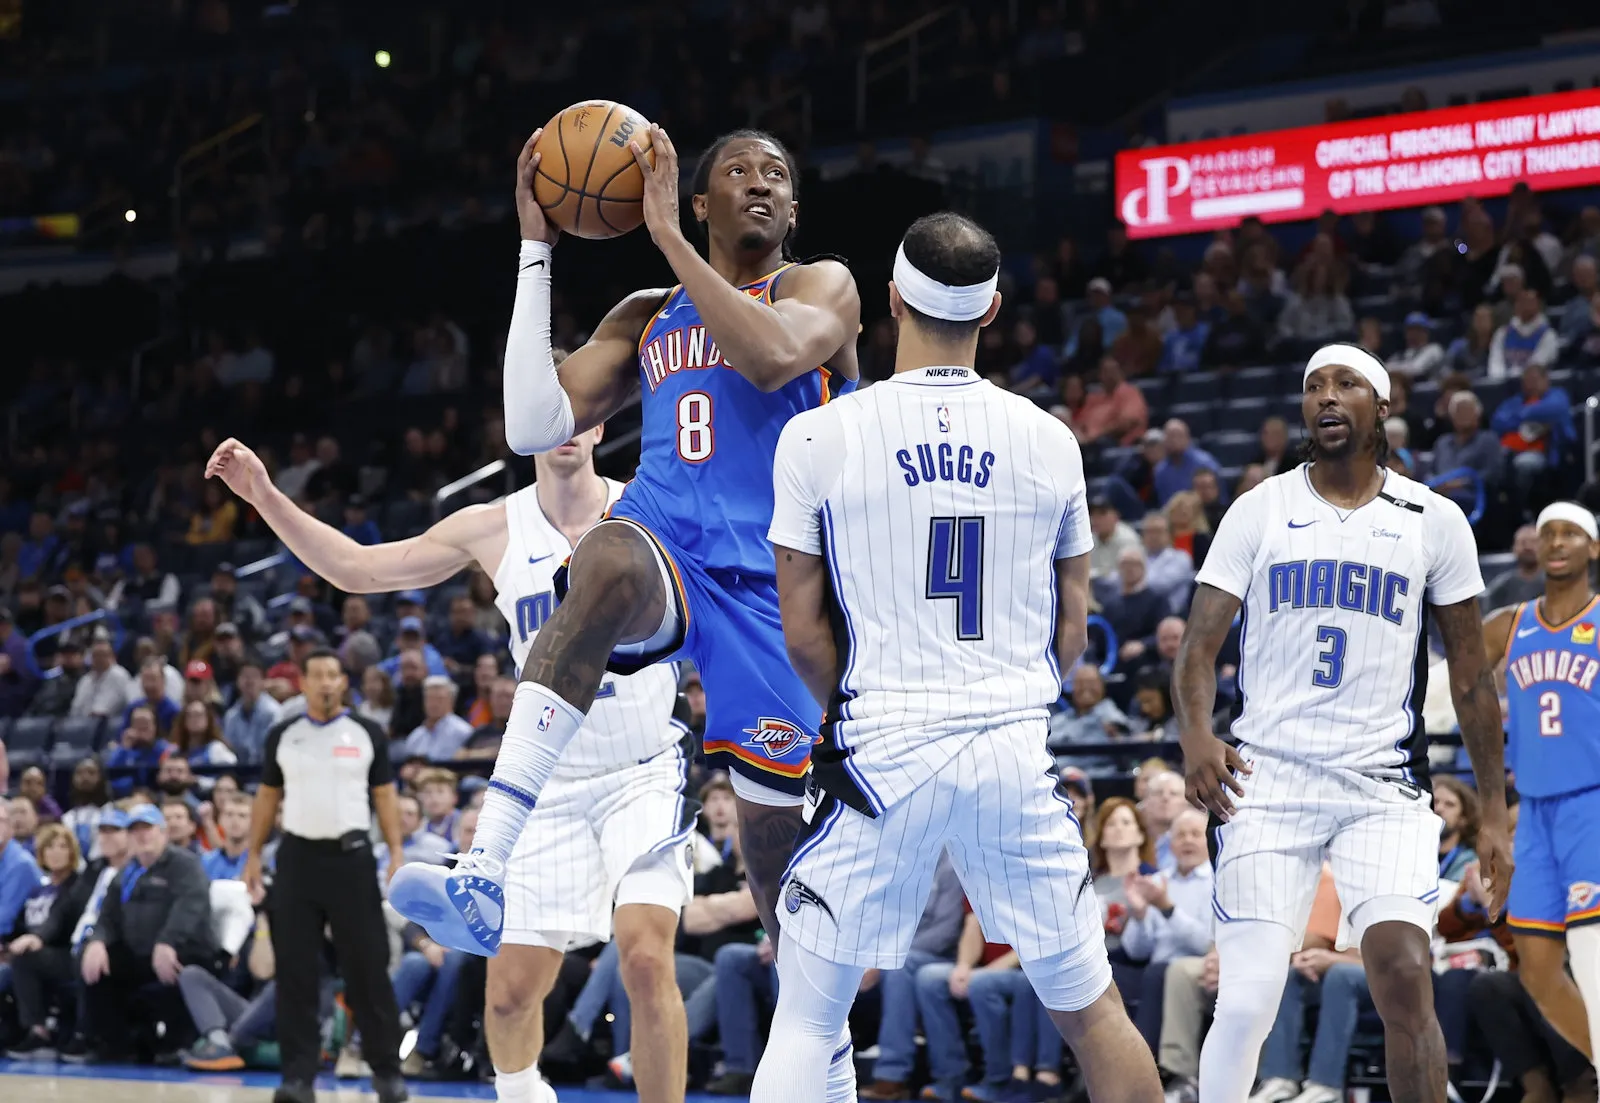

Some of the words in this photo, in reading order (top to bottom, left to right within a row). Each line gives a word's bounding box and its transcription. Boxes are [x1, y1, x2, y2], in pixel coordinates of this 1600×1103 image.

[1315, 133, 1389, 169] OFFICIAL
[1390, 123, 1474, 159] PERSONAL
[1475, 114, 1536, 148] INJURY
[1328, 170, 1353, 199] OF
[1354, 166, 1385, 197] THE
[1385, 154, 1482, 192] OKLAHOMA
[1483, 148, 1523, 180] CITY
[925, 368, 950, 378] NIKE
[951, 368, 969, 378] PRO
[676, 390, 715, 463] 8
[896, 442, 996, 489] SUGGS
[925, 516, 985, 641] 4
[1269, 559, 1410, 626] MAGIC
[1312, 625, 1347, 689] 3
[1509, 648, 1600, 692] THUNDER
[752, 728, 794, 742] OKC
[1539, 690, 1563, 737] 2
